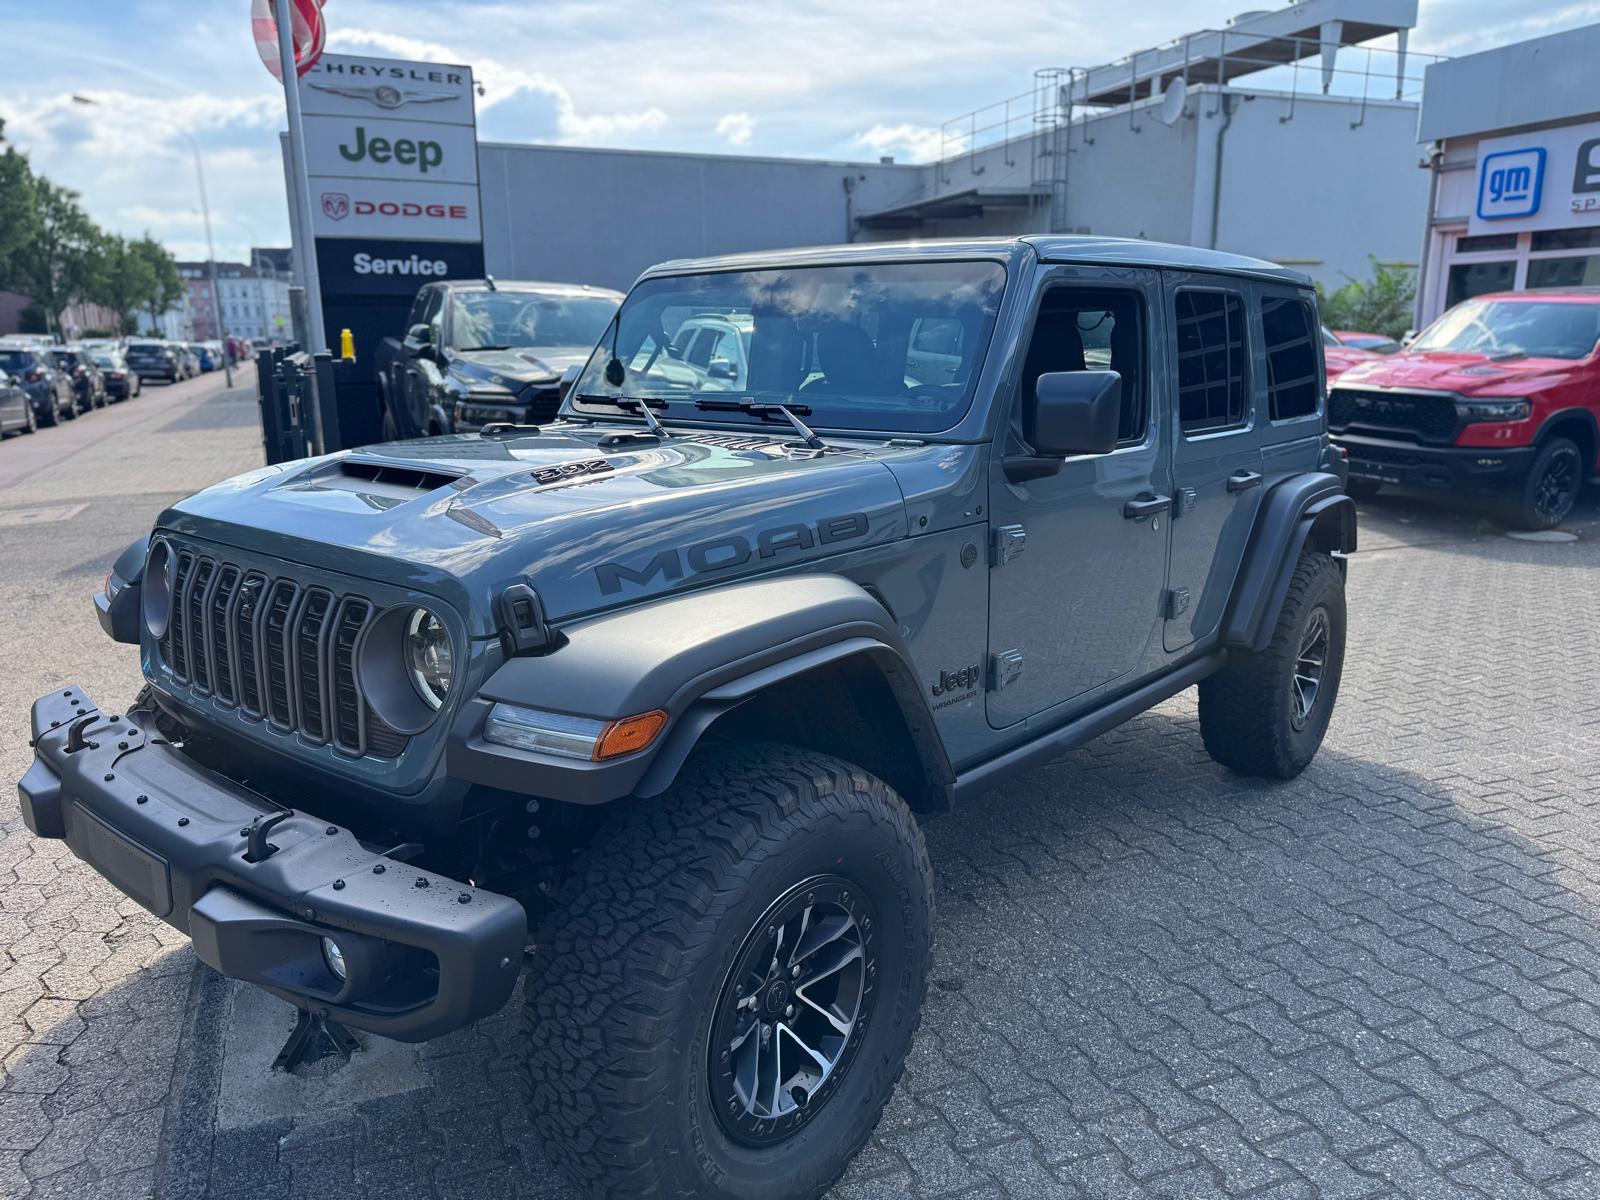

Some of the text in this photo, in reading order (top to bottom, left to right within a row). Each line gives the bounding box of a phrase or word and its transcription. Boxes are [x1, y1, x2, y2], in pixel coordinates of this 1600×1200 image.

[338, 126, 443, 173] Jeep
[1489, 166, 1531, 203] gm
[354, 200, 468, 219] DODGE
[353, 252, 448, 276] Service
[530, 458, 615, 486] 392
[594, 512, 870, 596] MOAB
[931, 663, 980, 697] Jeep
